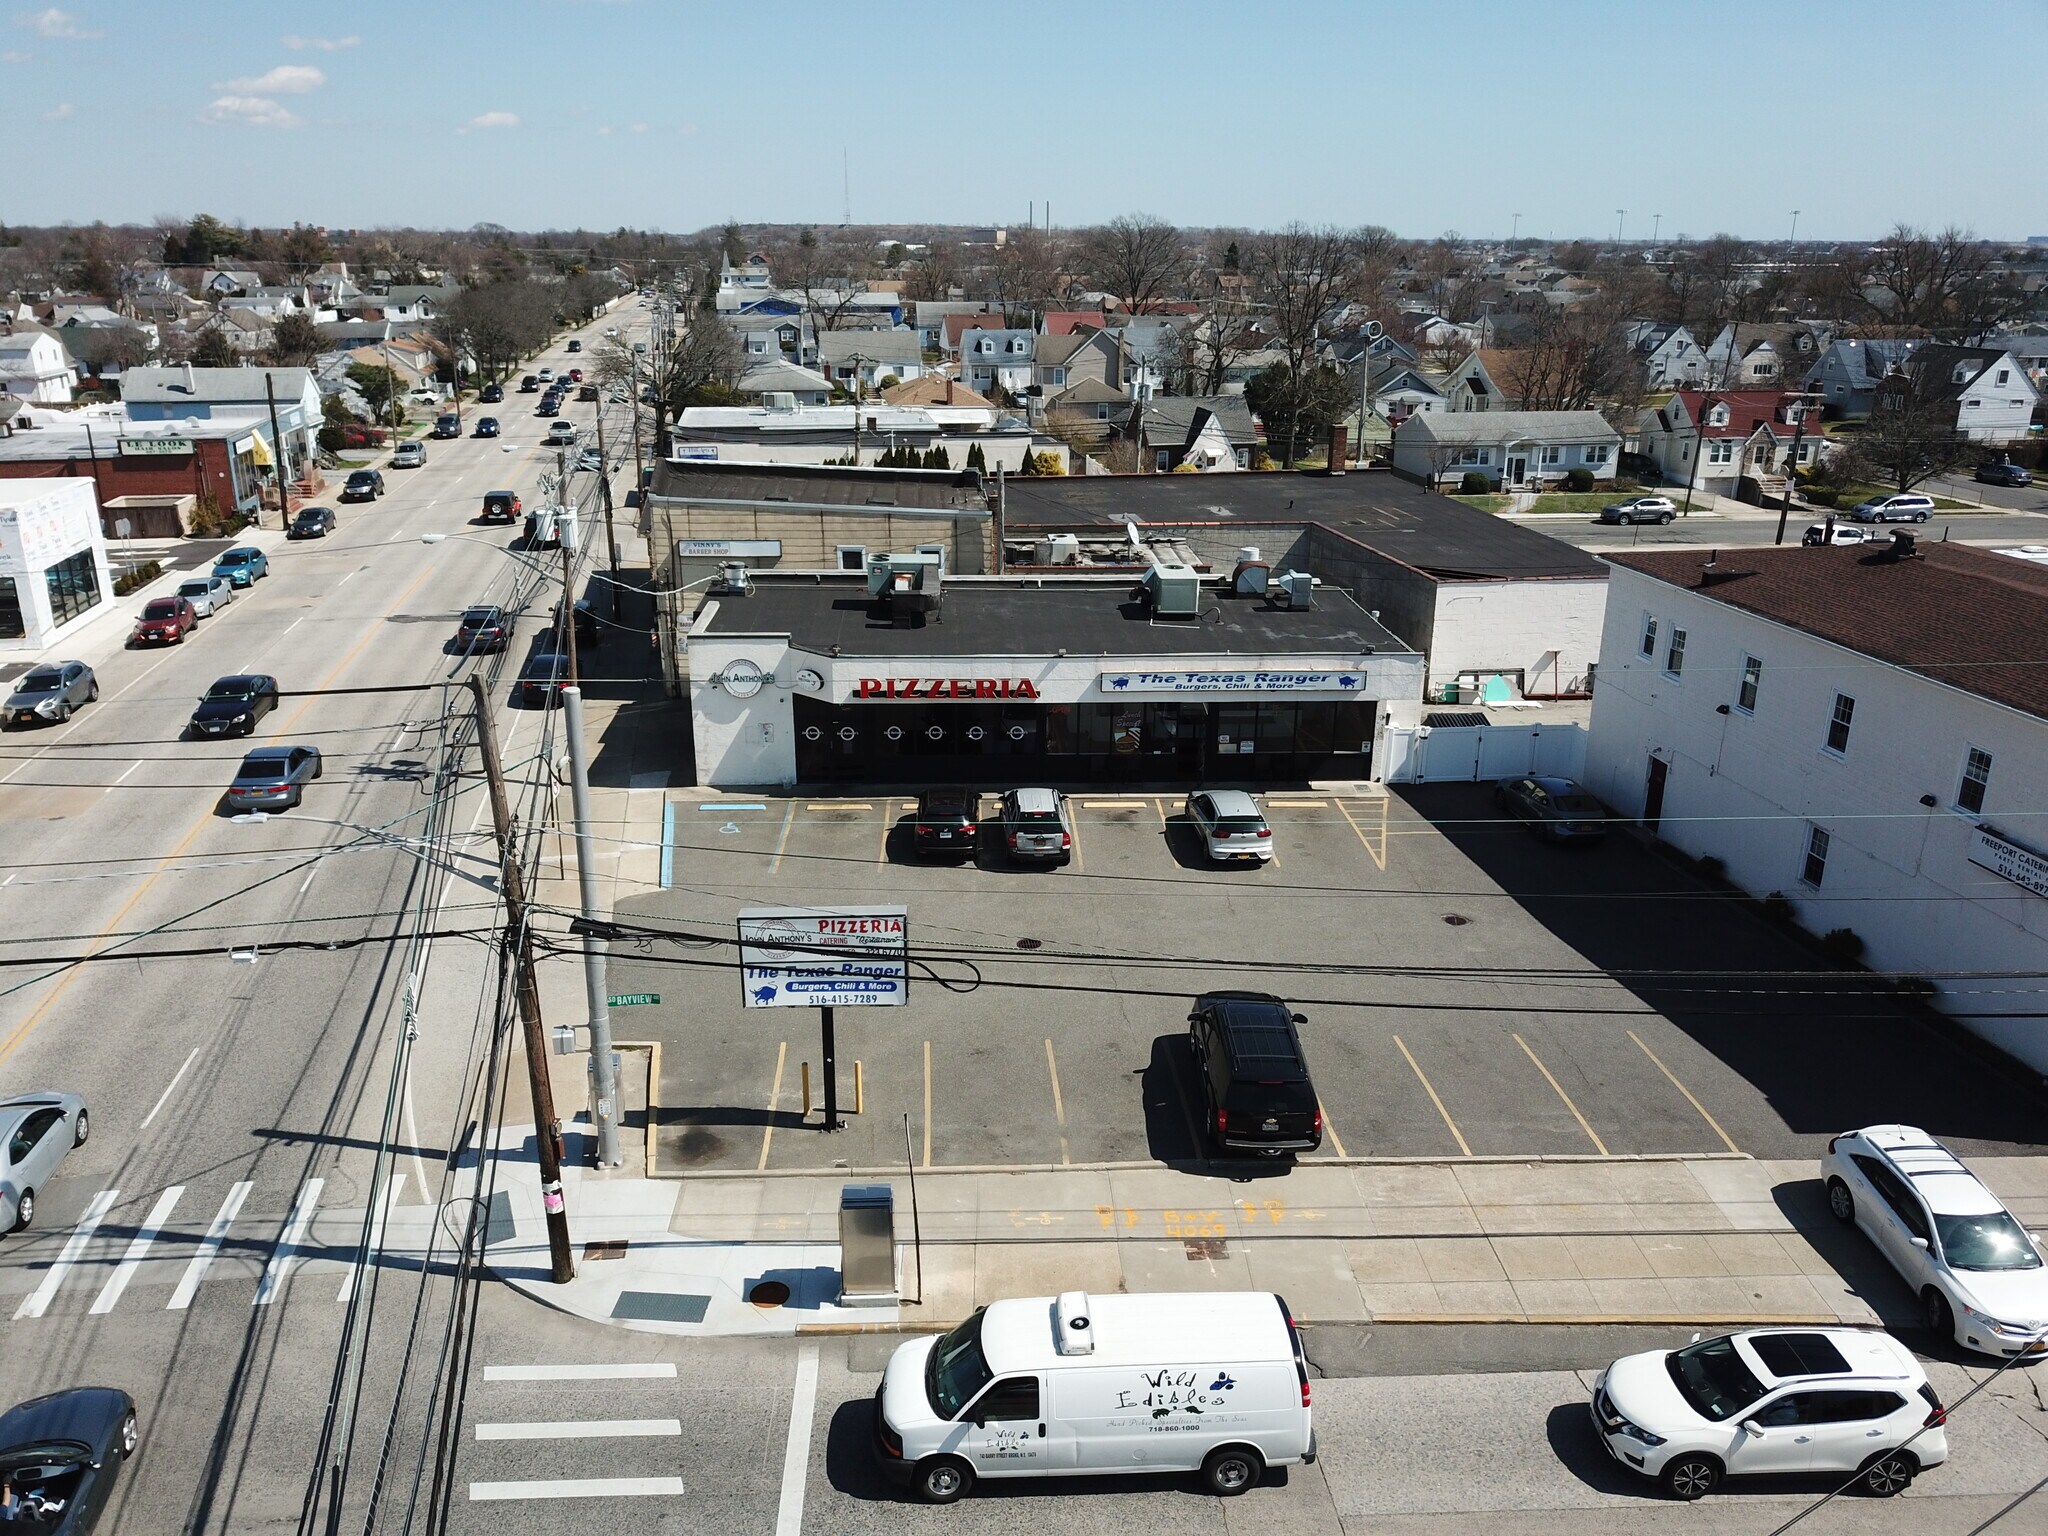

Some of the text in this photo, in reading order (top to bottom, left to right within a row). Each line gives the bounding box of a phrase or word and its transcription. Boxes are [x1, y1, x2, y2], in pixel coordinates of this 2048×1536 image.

[1138, 673, 1331, 685] The Texas Ranger
[859, 678, 1041, 699] PIZZERIA
[1174, 683, 1221, 691] Burgers,
[1121, 710, 1141, 718] Lunch
[1981, 836, 2018, 859] FREEPORT
[1994, 852, 2042, 880] PARTY RENTAL
[817, 919, 902, 933] PIZZERIA
[767, 933, 812, 944] ANTHONY'S
[819, 937, 848, 945] CATERING
[747, 963, 902, 980] The Texas Ranger
[791, 981, 892, 991] Burgers, Chili & More
[616, 994, 652, 1005] BAYVIEW
[808, 994, 878, 1004] 516-415-7289
[1140, 1369, 1197, 1389] Wild
[1114, 1388, 1226, 1410] Edibles
[1128, 1417, 1153, 1427] Picked
[1195, 1416, 1213, 1424] From
[1214, 1415, 1228, 1423] The
[995, 1429, 1016, 1438] Wild
[985, 1438, 1026, 1448] Edibles
